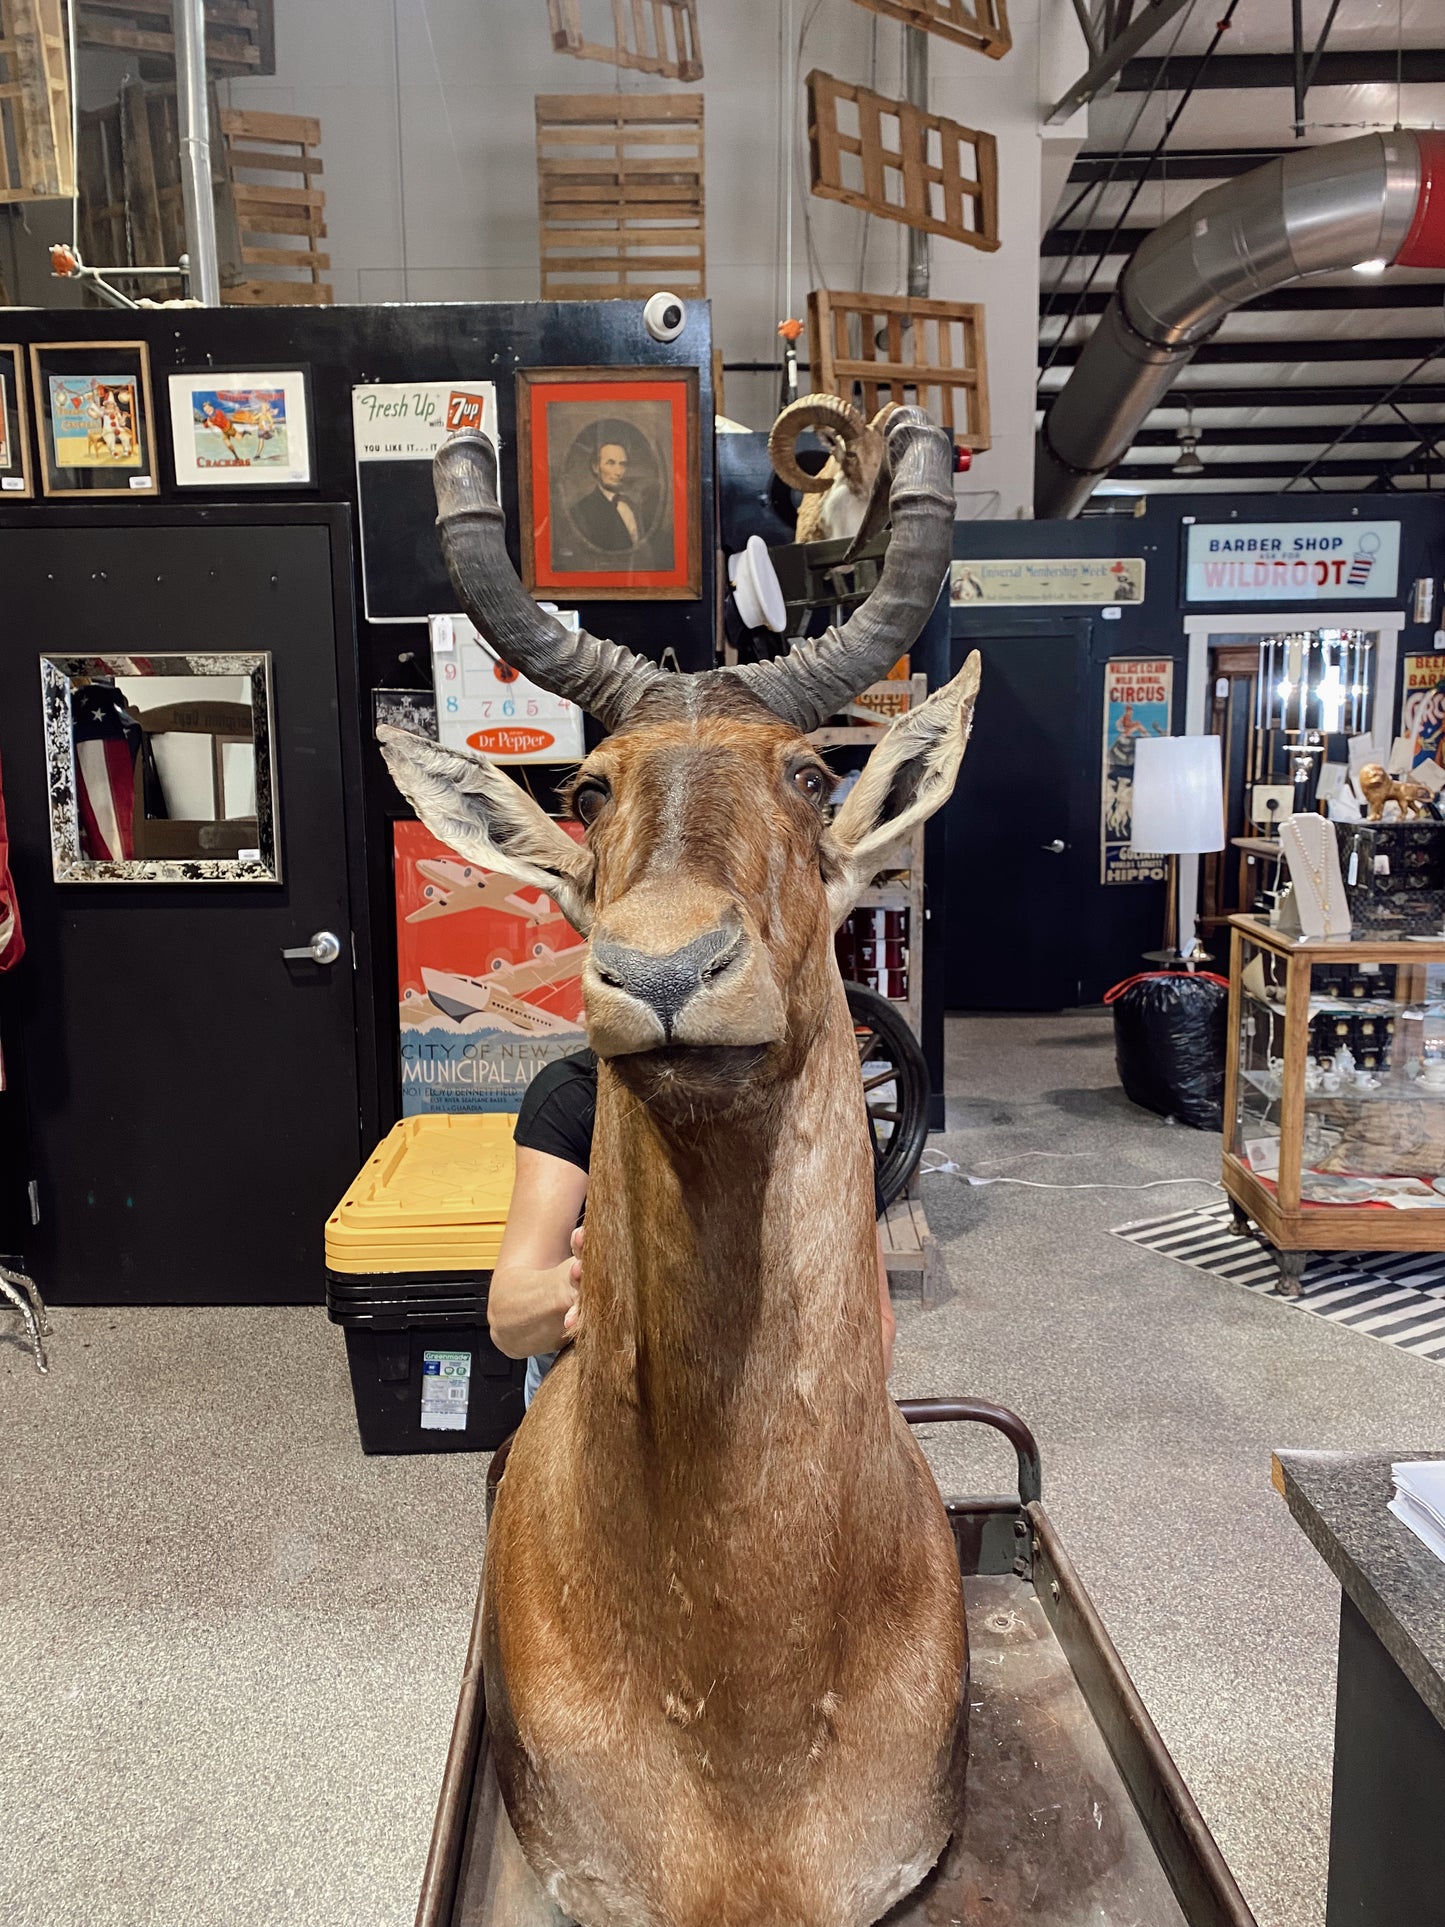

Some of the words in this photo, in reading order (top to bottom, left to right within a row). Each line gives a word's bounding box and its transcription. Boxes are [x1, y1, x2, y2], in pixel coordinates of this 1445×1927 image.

[385, 444, 402, 452] LIKE
[1209, 539, 1282, 551] BARBER
[1294, 537, 1344, 550] SHOP
[1203, 560, 1347, 588] WILDROOT
[444, 664, 457, 680] 9
[1409, 674, 1445, 686] BAR
[1110, 686, 1165, 702] CIRCUS
[446, 696, 459, 713] 8
[482, 701, 493, 717] 7
[503, 700, 515, 716] 6
[527, 700, 538, 716] 5
[479, 735, 495, 747] Dr
[498, 731, 545, 752] Pepper
[1107, 868, 1164, 881] HIPPO
[401, 1044, 456, 1059] CITY
[463, 1044, 490, 1059] OF
[502, 1044, 549, 1058] NEW
[402, 1060, 510, 1083] MUNICIPAL
[455, 1087, 494, 1096] BENNETT
